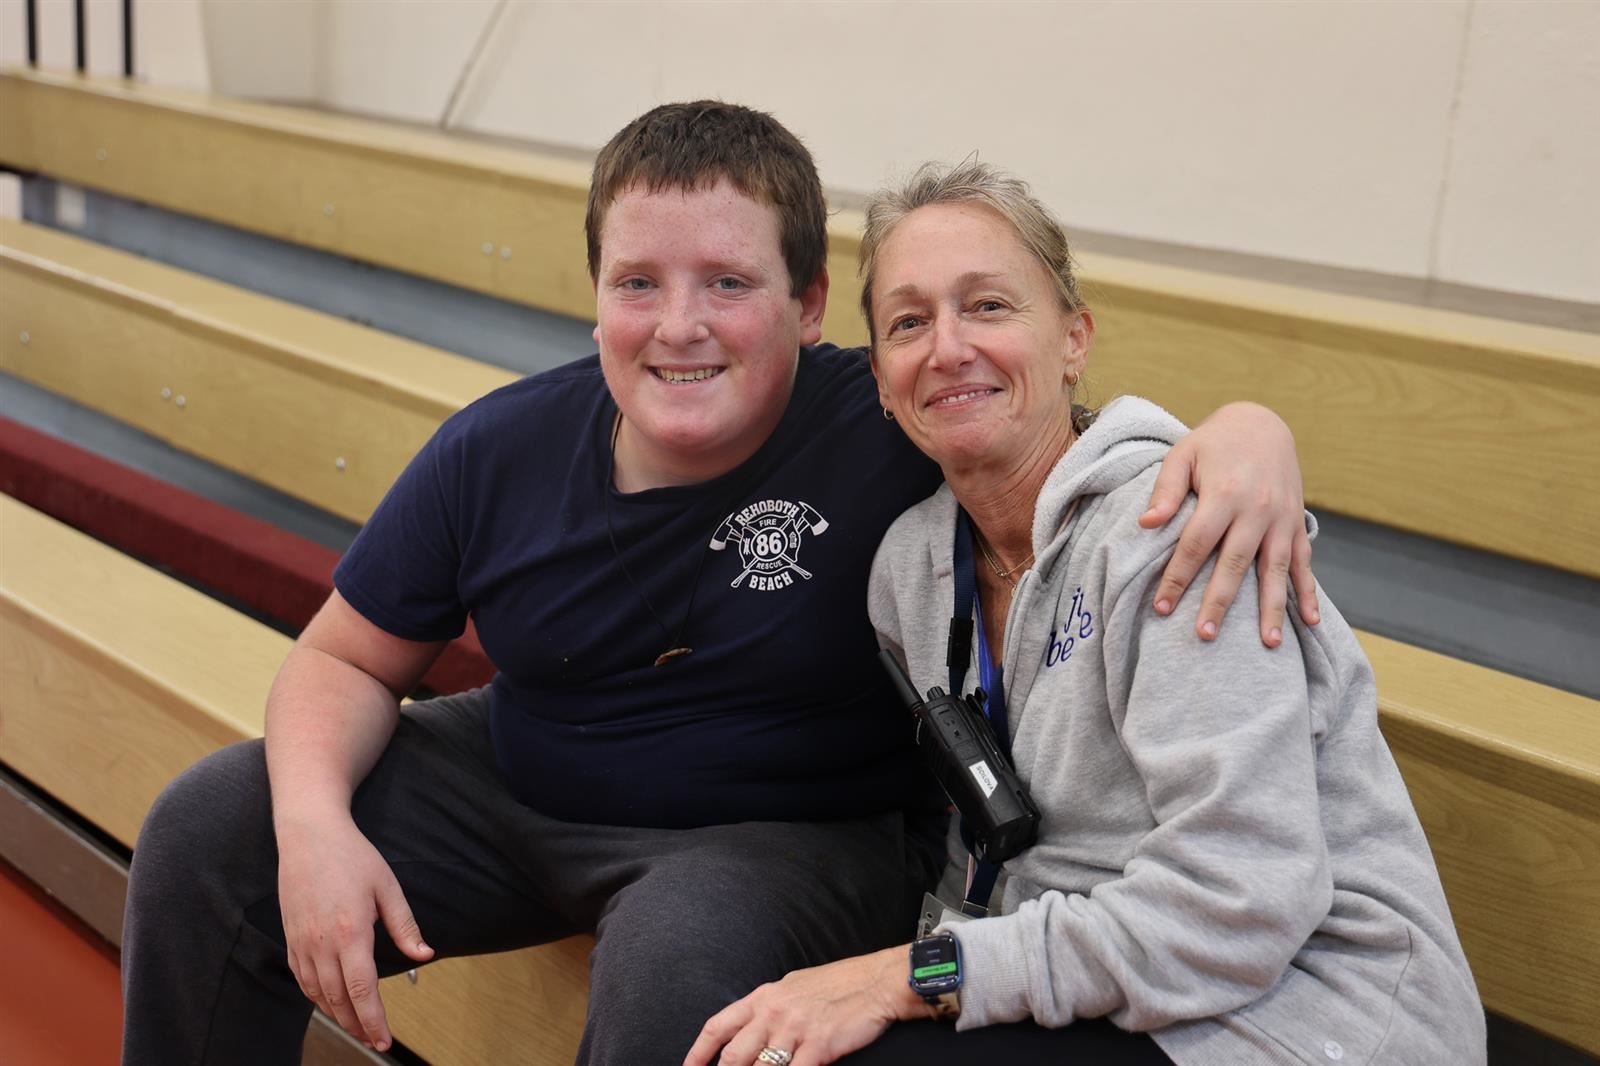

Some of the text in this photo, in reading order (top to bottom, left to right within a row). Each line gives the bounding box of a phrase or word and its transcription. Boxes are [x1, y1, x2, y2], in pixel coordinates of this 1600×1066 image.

[735, 500, 800, 526] REHOBOTH
[759, 518, 777, 527] FIRE
[756, 531, 782, 556] 86
[756, 560, 783, 570] RESCUE
[748, 571, 794, 591] BEACH
